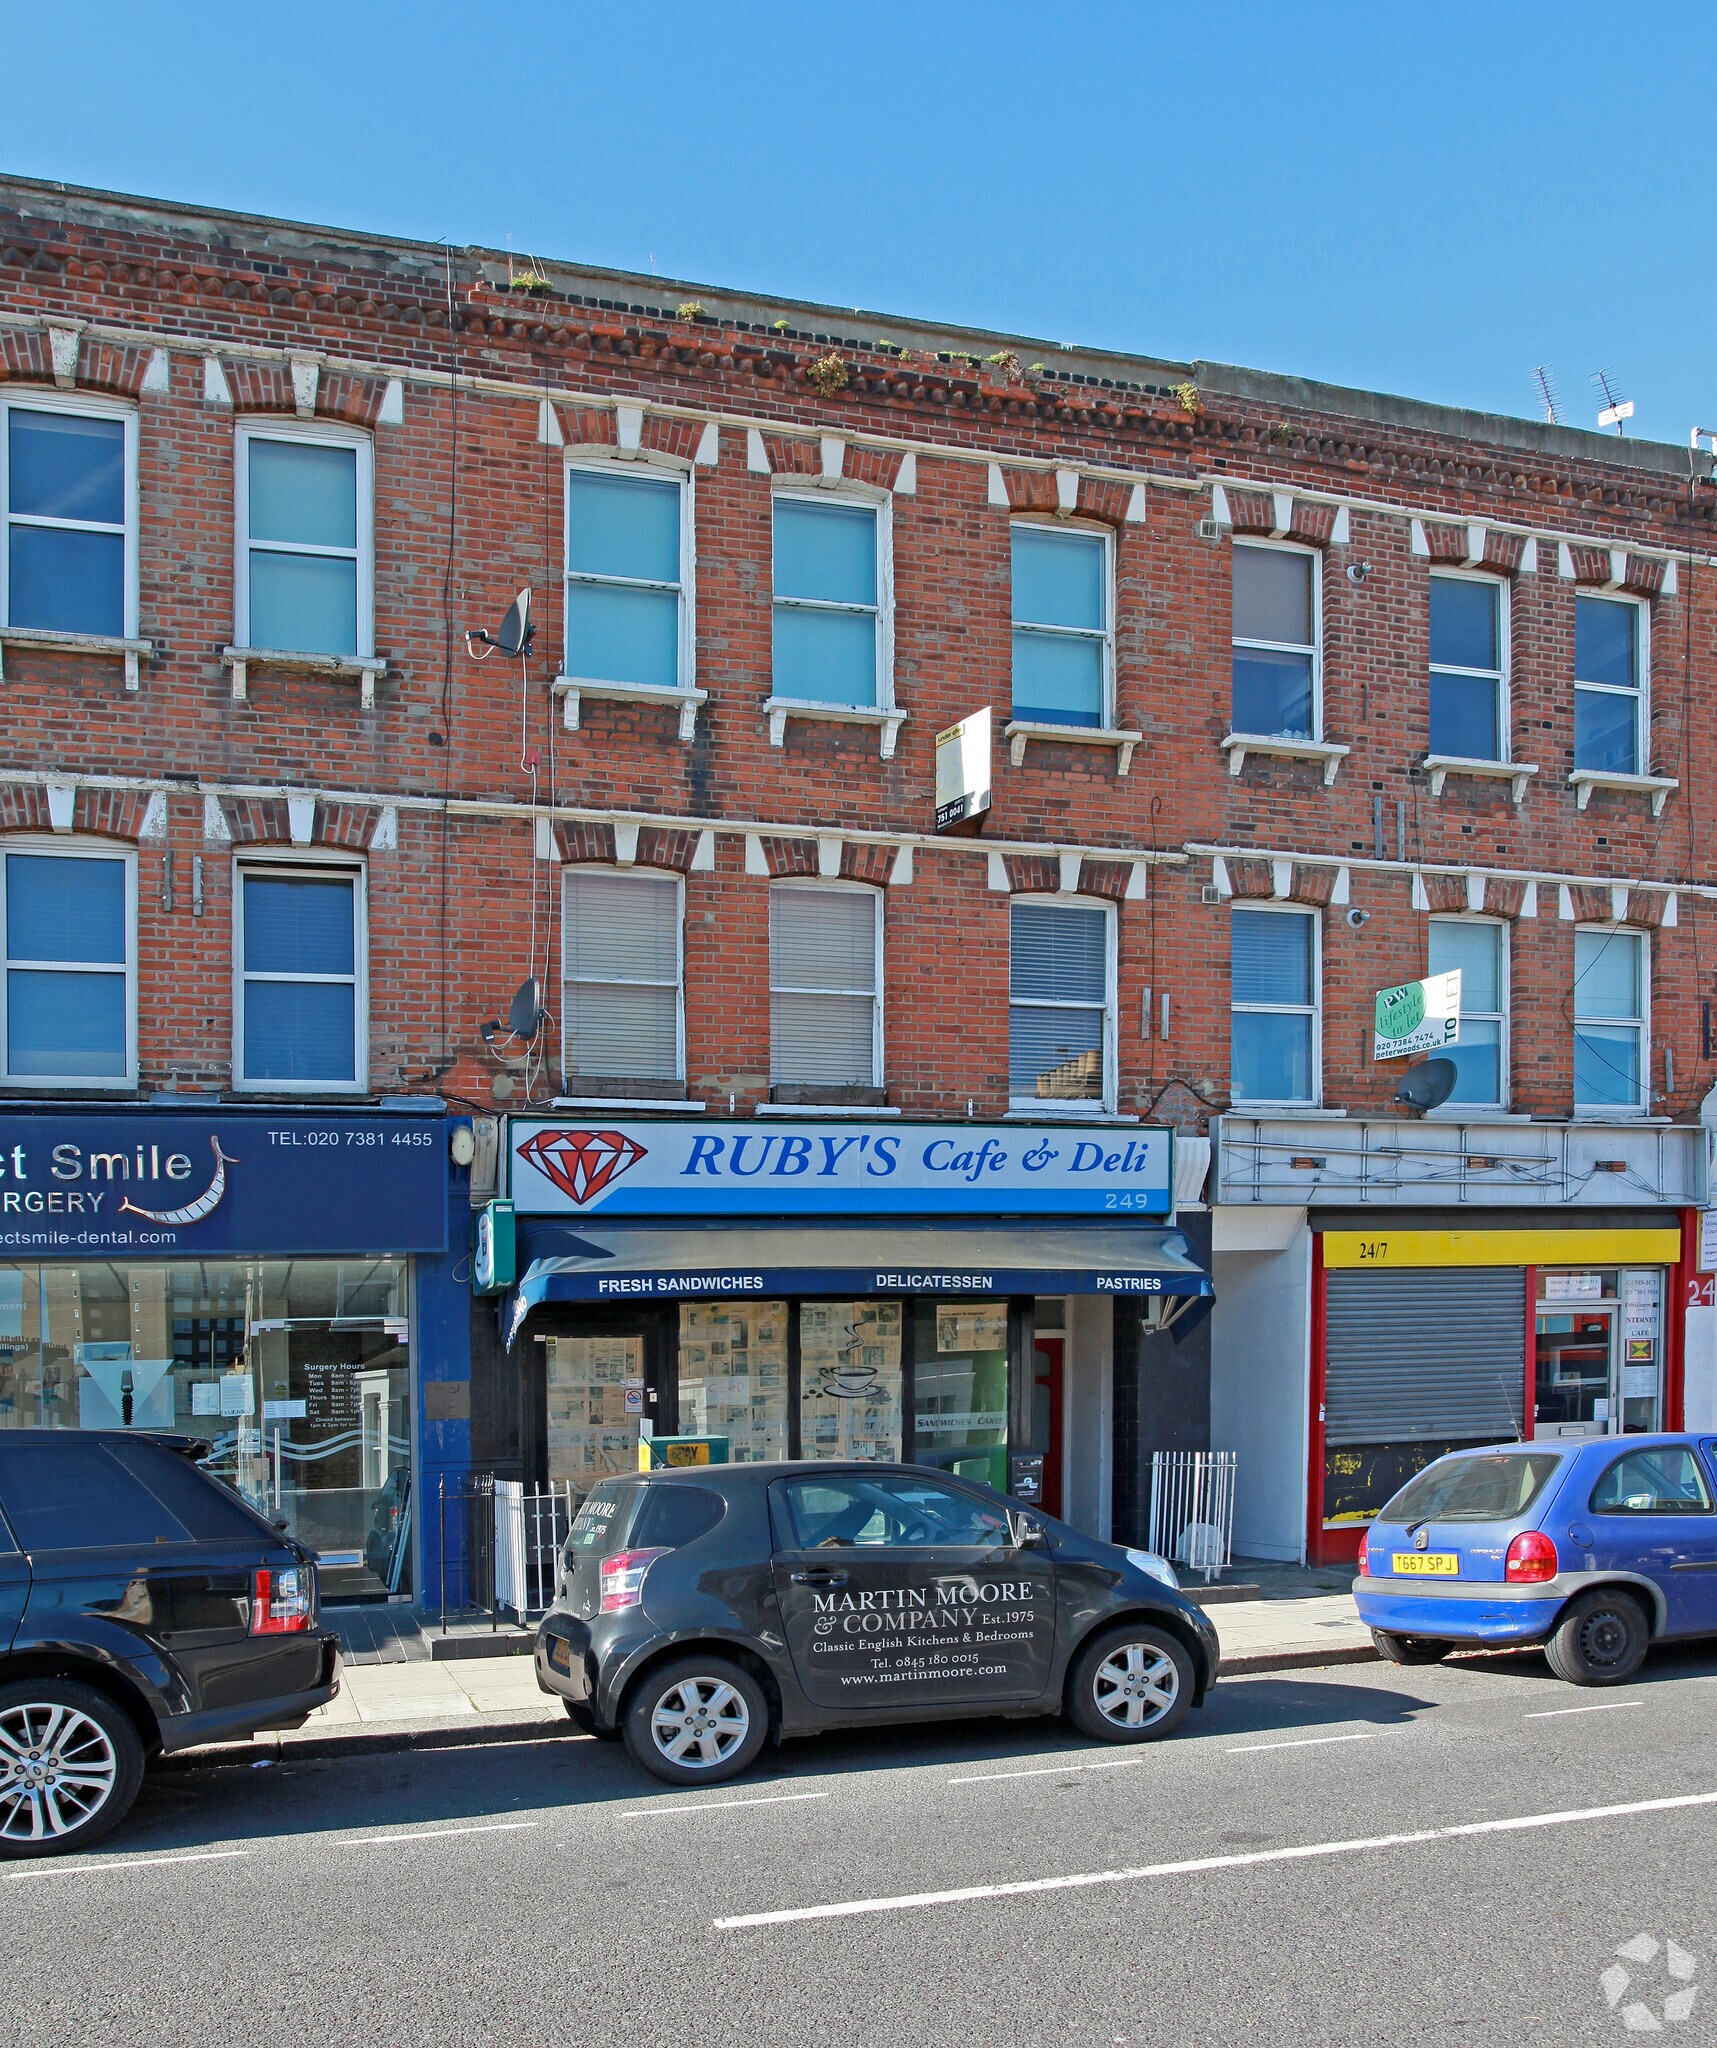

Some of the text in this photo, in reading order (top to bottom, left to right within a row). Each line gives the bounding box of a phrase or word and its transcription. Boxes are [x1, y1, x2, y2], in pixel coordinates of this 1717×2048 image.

[1383, 986, 1409, 1009] PW
[1379, 994, 1422, 1029] lifestyle
[1443, 976, 1458, 1043] TO LET
[1392, 1012, 1420, 1037] to let
[1375, 1038, 1441, 1060] peterwoods.co.uk
[1376, 1032, 1434, 1051] 020 7384 7474
[267, 1132, 433, 1146] TEL:020 7381 4455
[51, 1143, 192, 1181] Smile
[680, 1134, 1149, 1182] RUBY'S Cafe & Deli
[4, 1191, 106, 1214] RGERY
[1105, 1193, 1148, 1210] 249
[1359, 1241, 1388, 1261] 24/7
[599, 1276, 764, 1293] FRESH SANDWICHES
[875, 1274, 993, 1289] DELICATESSEN
[1096, 1277, 1162, 1291] PASTRIES
[304, 1363, 338, 1372] Surgery
[1396, 1556, 1453, 1571] T667 SPJ
[812, 1581, 1034, 1613] MARTIN MOORE
[813, 1607, 1034, 1636] & COMPANY Est.1975
[813, 1630, 1034, 1653] Classic English Kitchens & Bedrooms
[870, 1653, 979, 1669] Tel. 0845 180 0015
[840, 1663, 1007, 1686] www.martinmoore.com
